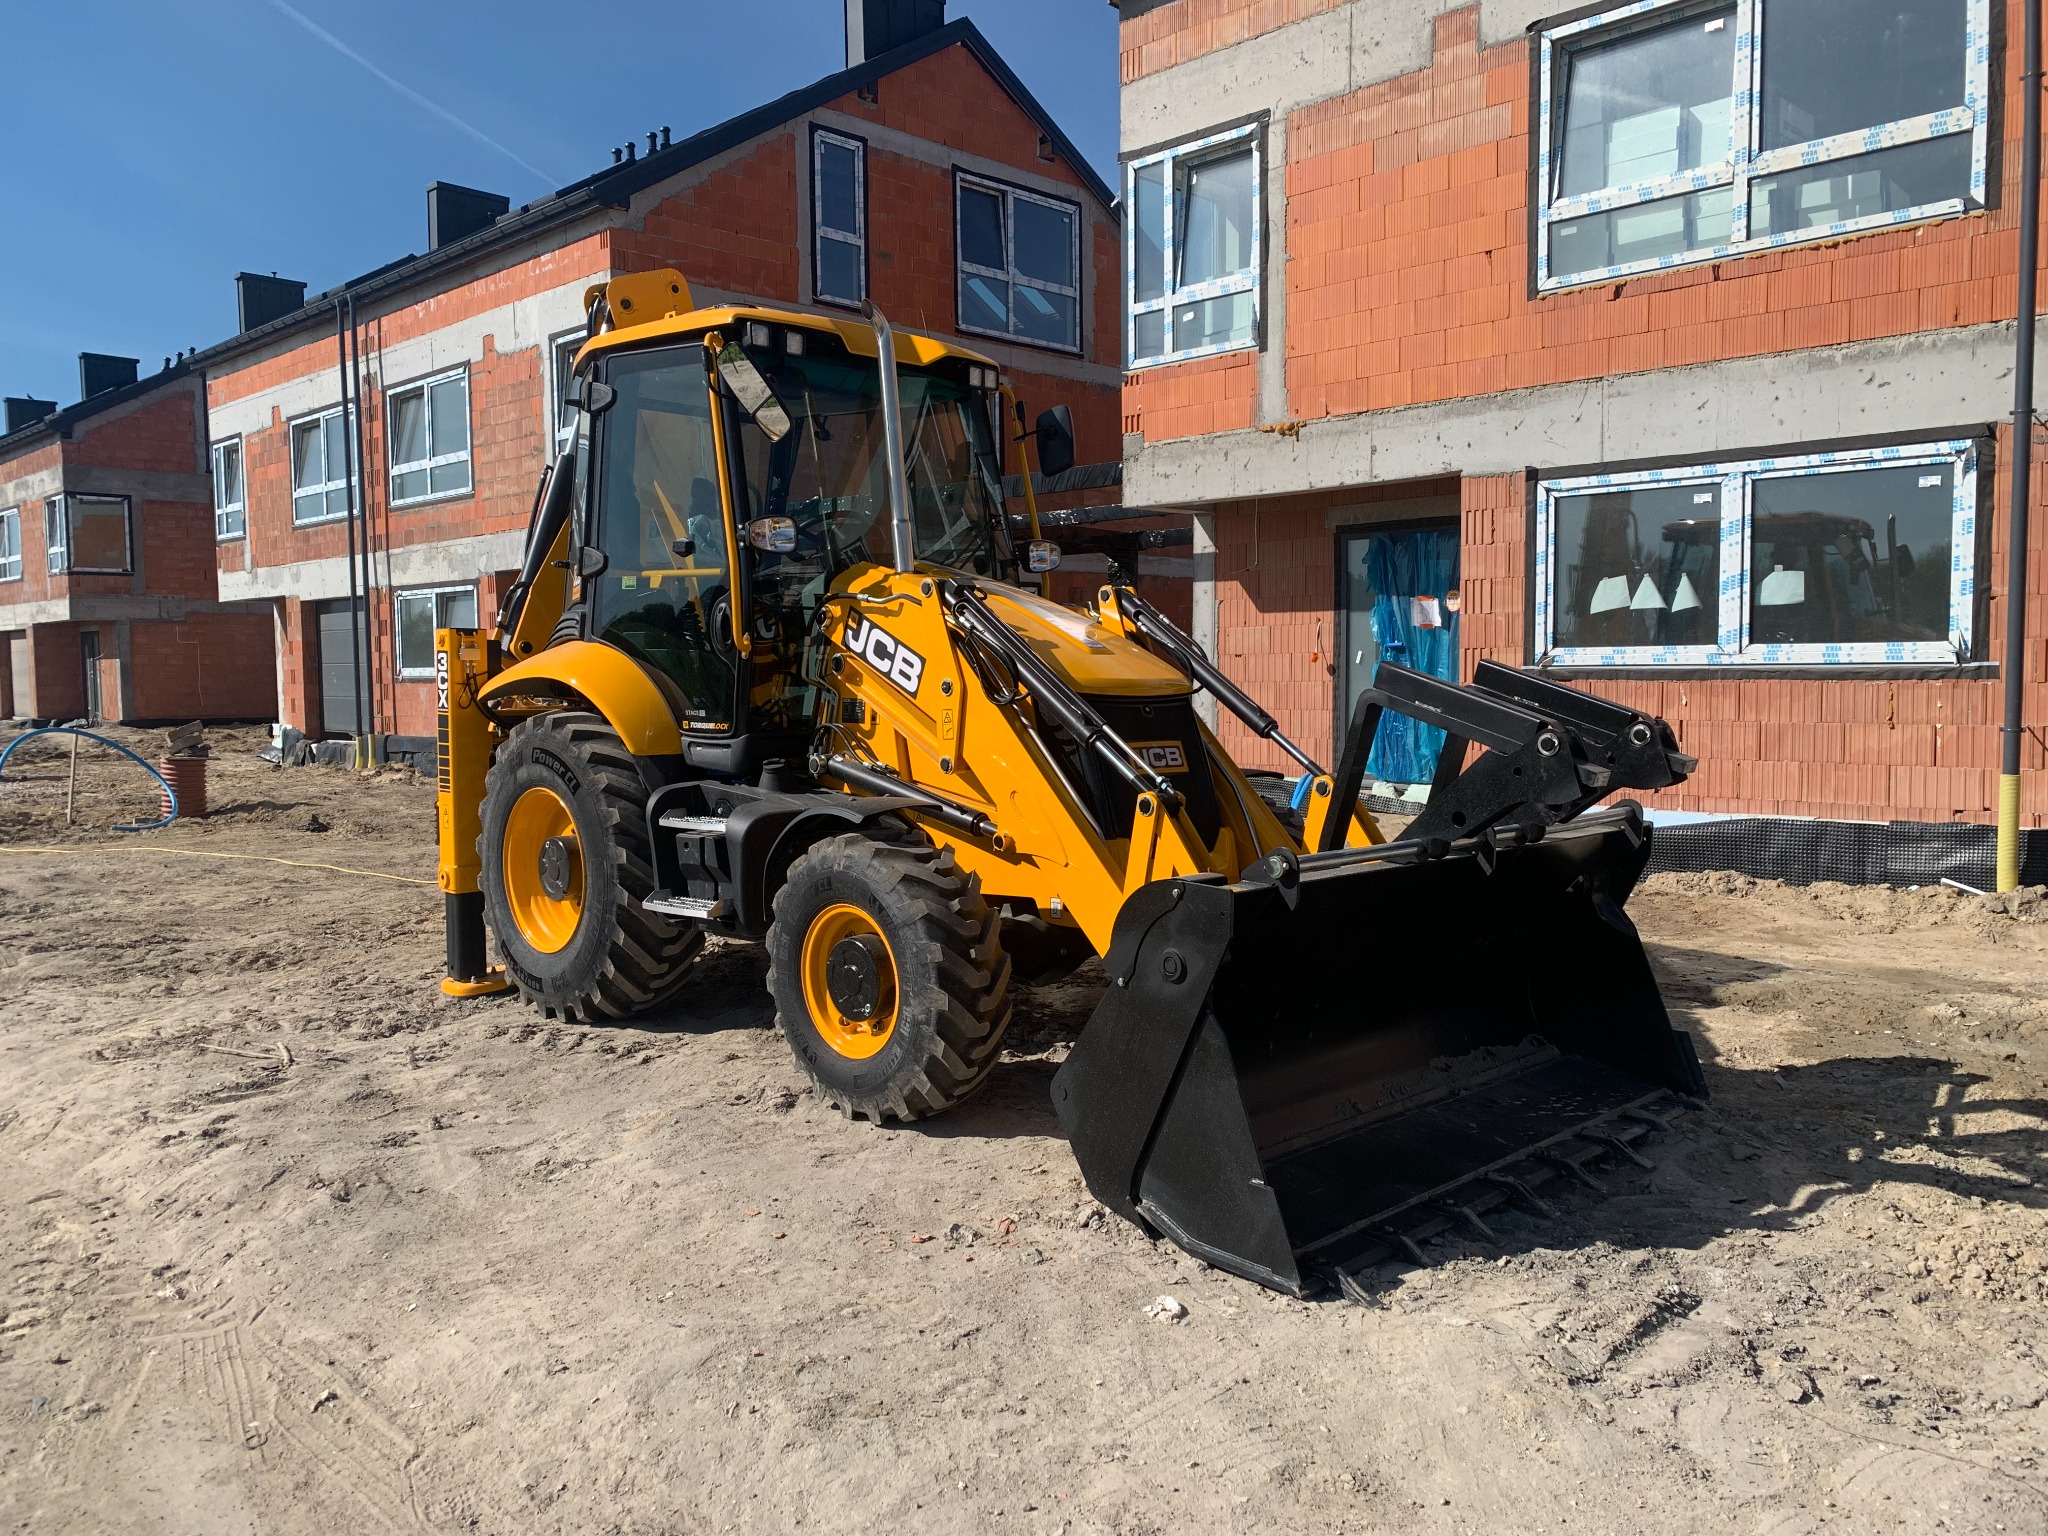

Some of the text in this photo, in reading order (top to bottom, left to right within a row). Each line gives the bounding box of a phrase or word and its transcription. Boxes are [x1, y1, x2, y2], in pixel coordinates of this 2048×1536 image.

[1801, 150, 1817, 158] VEKA
[845, 619, 922, 692] JCB
[437, 652, 448, 708] 3CX
[533, 750, 565, 775] Power
[565, 772, 577, 793] CL
[1135, 747, 1182, 767] JCB
